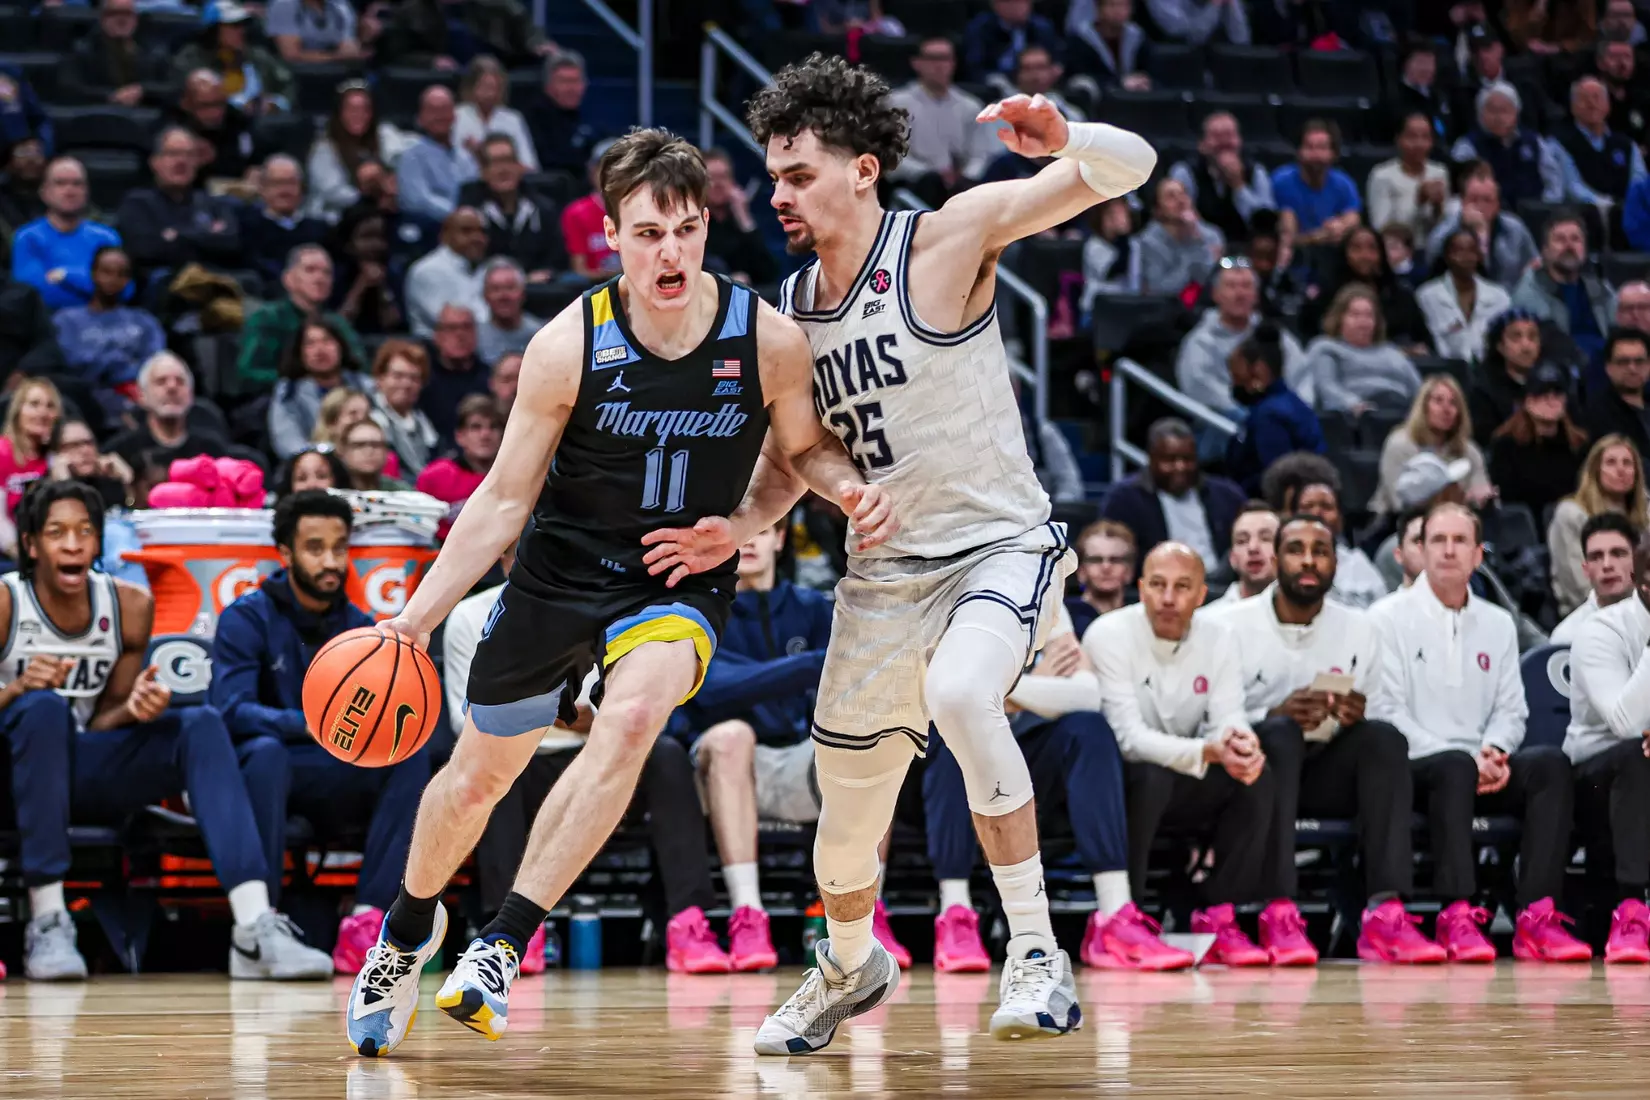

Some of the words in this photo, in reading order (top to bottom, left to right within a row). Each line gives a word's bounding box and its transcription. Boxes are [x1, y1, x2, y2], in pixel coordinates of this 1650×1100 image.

[862, 303, 887, 316] EAST
[864, 299, 882, 310] BIG
[714, 386, 744, 394] EAST
[716, 380, 738, 388] BIG
[595, 401, 748, 447] Marquette
[829, 401, 894, 470] 25
[640, 447, 690, 513] 11
[364, 566, 408, 615] G
[150, 640, 213, 694] G
[332, 685, 377, 753] ELITE
